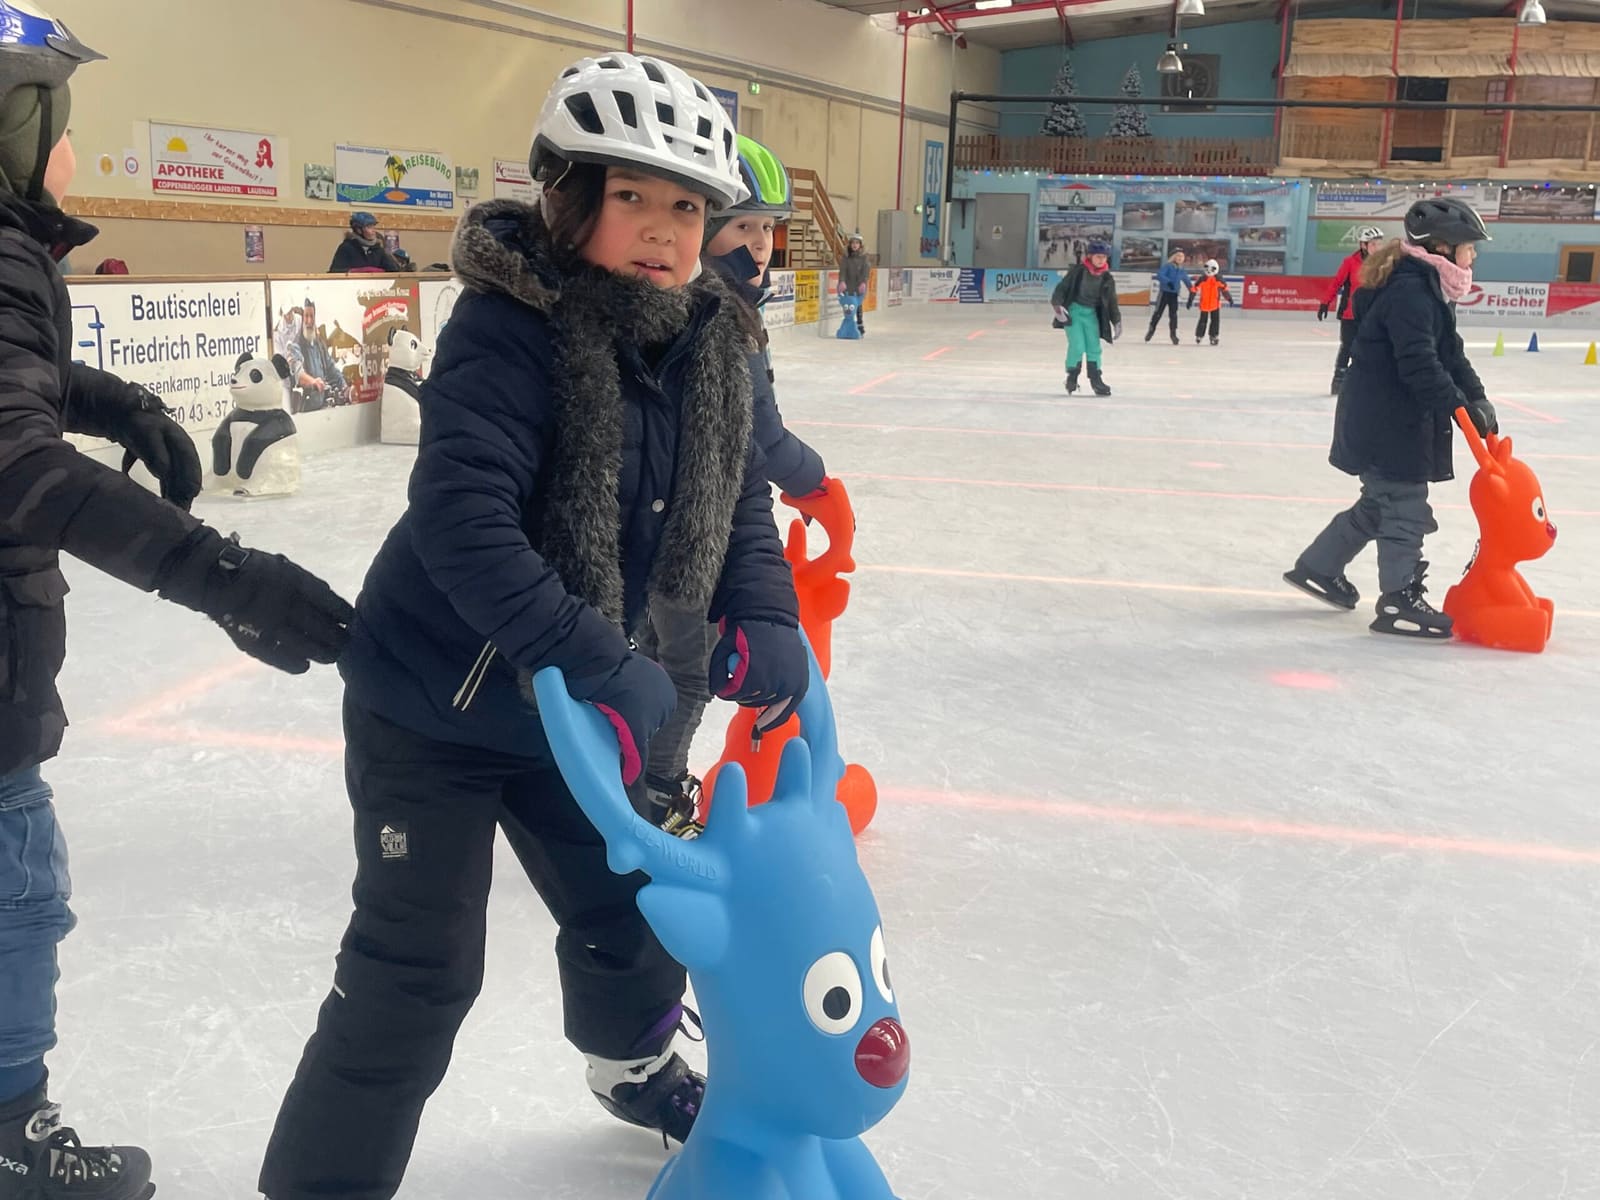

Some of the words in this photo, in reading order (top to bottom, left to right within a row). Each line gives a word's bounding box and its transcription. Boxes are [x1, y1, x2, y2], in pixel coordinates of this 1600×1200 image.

[158, 163, 225, 180] APOTHEKE
[405, 154, 452, 180] REISEBÜRO
[247, 186, 275, 196] LAUENAU
[996, 271, 1049, 291] BOWLING
[1507, 286, 1546, 296] Elektro
[1487, 294, 1545, 308] Fischer
[110, 334, 191, 367] Friedrich
[196, 333, 260, 358] Remmer
[189, 404, 203, 422] 43
